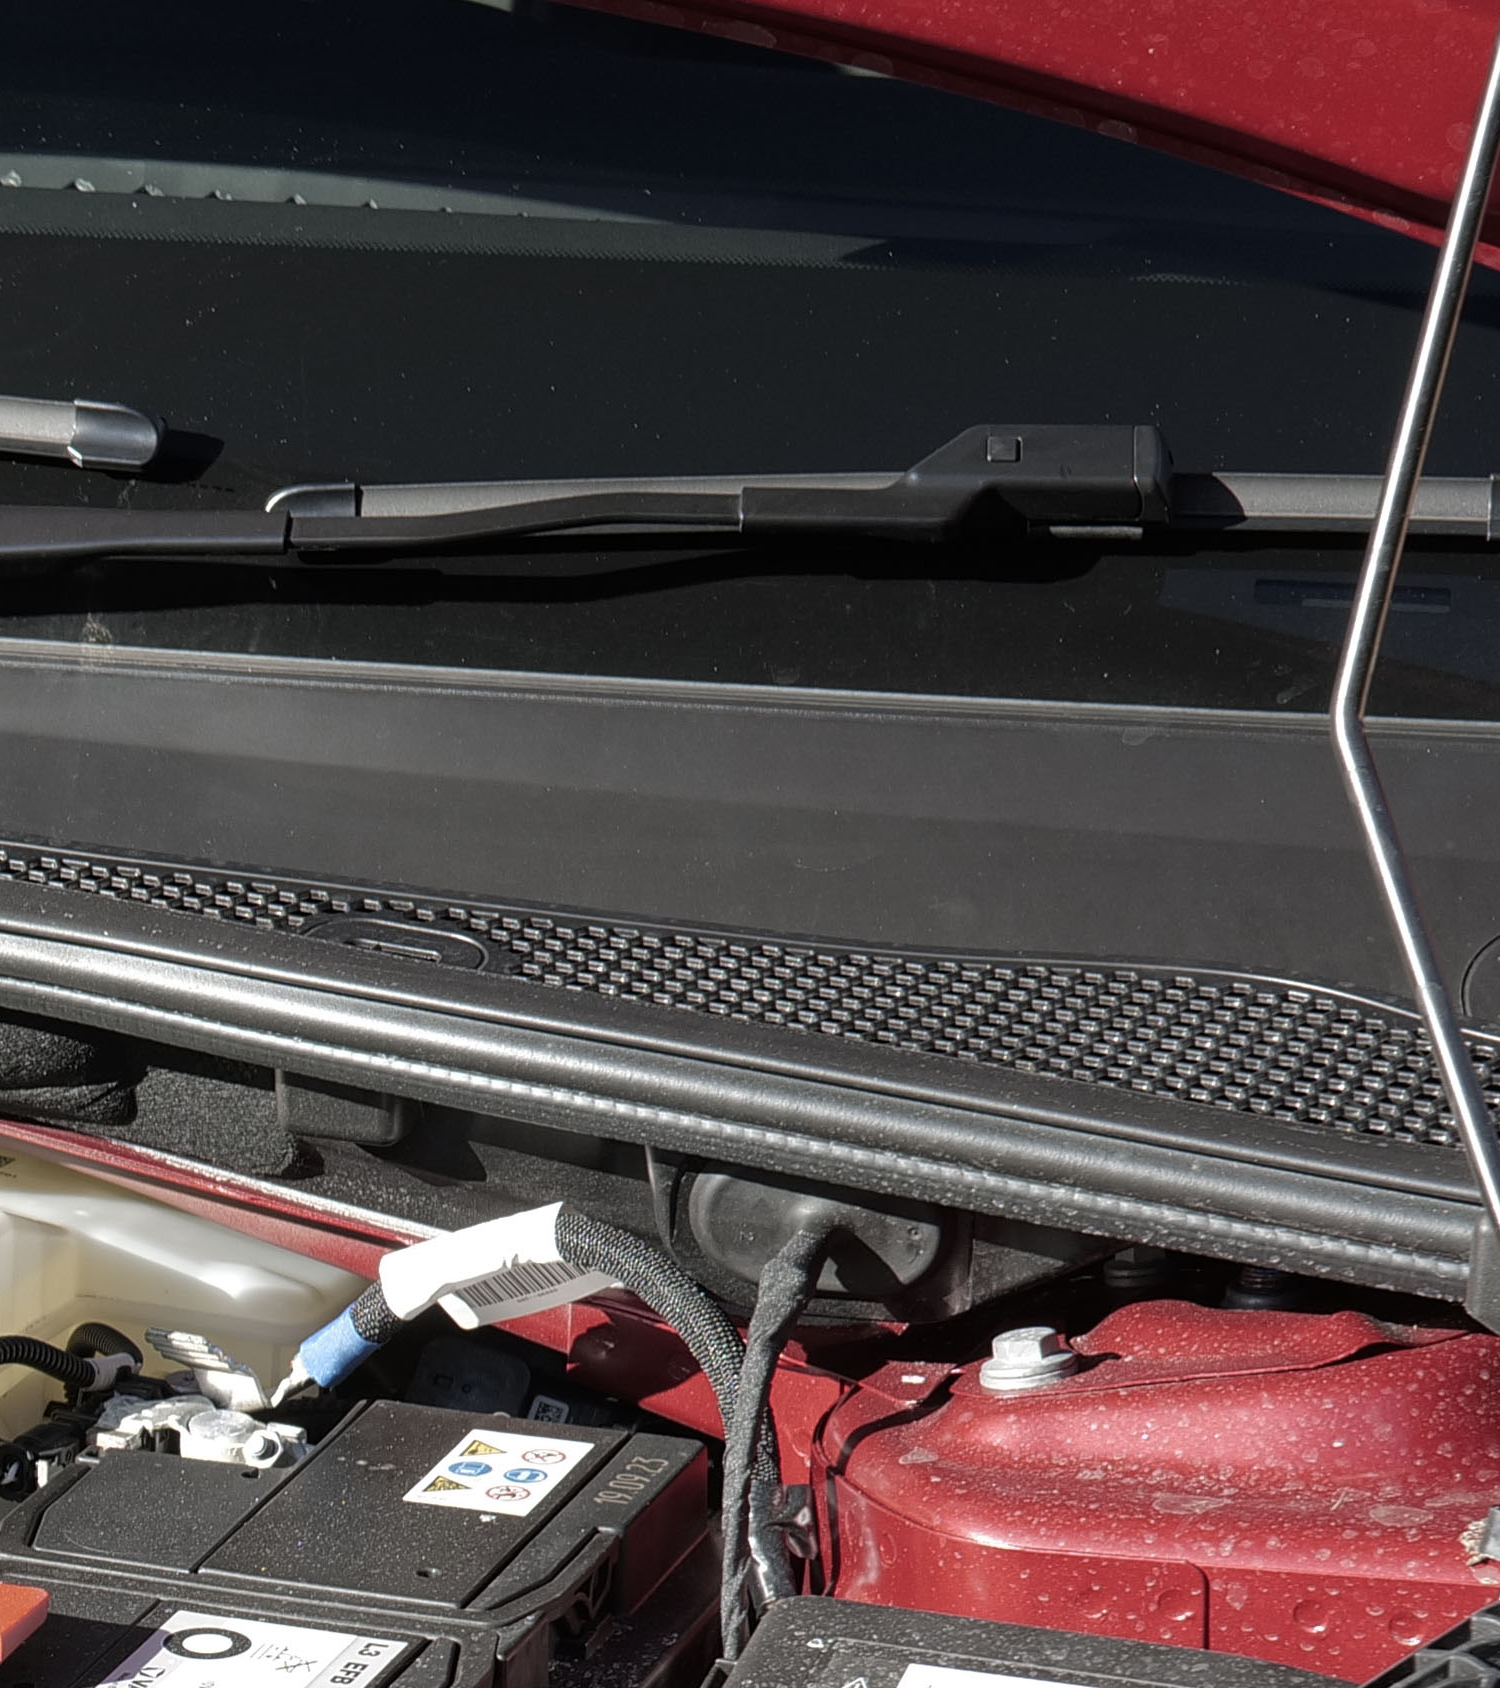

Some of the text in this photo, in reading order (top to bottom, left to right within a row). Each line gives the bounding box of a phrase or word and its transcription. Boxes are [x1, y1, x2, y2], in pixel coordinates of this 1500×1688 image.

[593, 1455, 670, 1505] 19.09.23
[357, 1642, 389, 1657] L3
[329, 1661, 369, 1685] EFB
